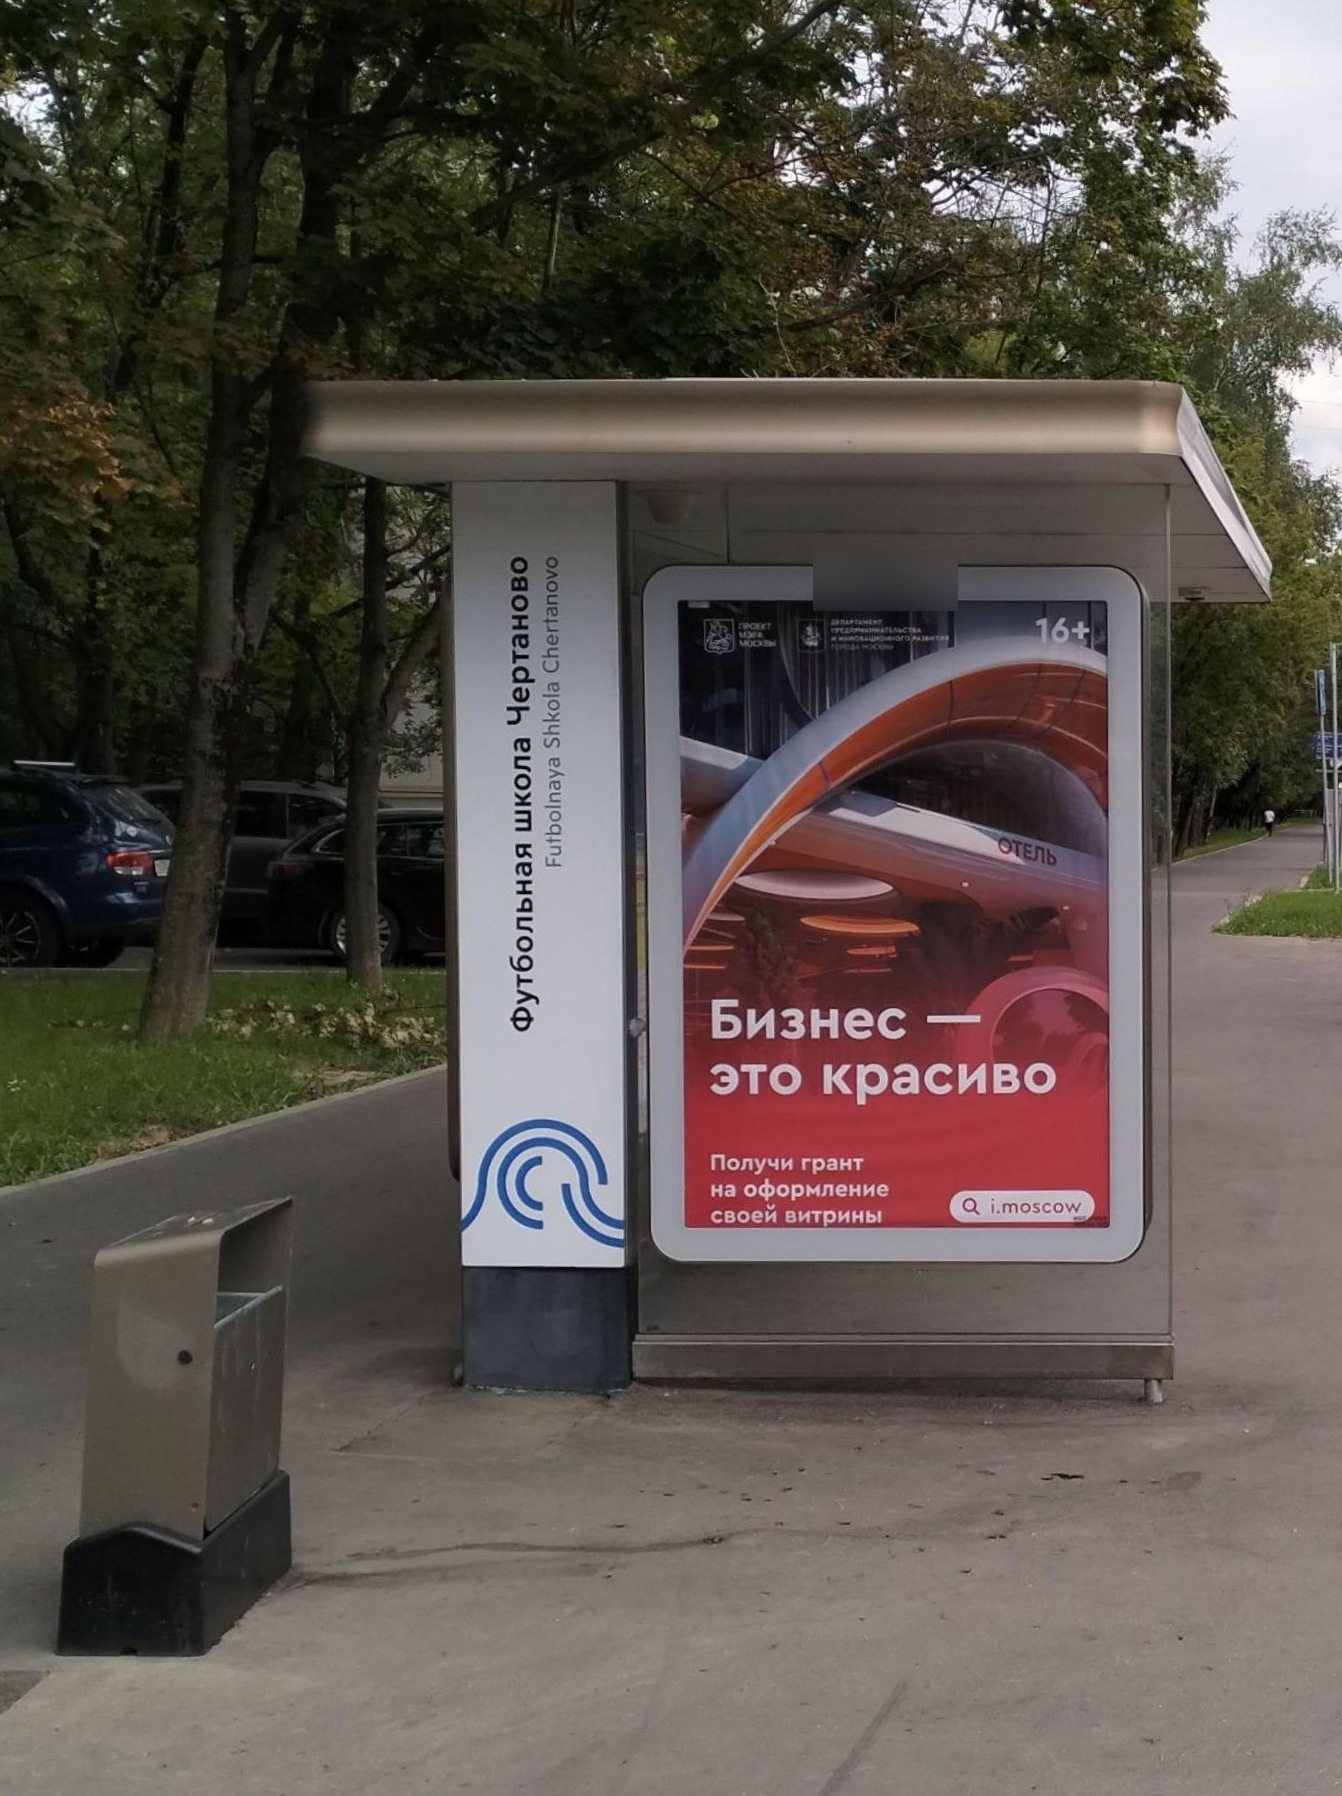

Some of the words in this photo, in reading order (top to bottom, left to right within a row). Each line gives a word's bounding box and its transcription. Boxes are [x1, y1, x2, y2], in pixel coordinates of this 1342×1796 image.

[541, 556, 560, 673] Chertanovo
[1035, 617, 1090, 644] 16+
[506, 556, 535, 726] Чертаново
[541, 681, 560, 749] Shkola
[513, 737, 532, 832] школа
[544, 756, 565, 867] Futbolnaya
[998, 837, 1057, 866] ОТЕЛЬ
[509, 843, 540, 1032] Футбольная
[711, 999, 907, 1040] Бизнес
[710, 1063, 802, 1095] это
[822, 1062, 1057, 1105] красиво
[710, 1154, 794, 1175] Получи
[801, 1157, 864, 1175] грант
[710, 1183, 736, 1198] на
[743, 1178, 890, 1201] оформление
[990, 1197, 1082, 1214] i.moscow
[710, 1204, 778, 1224] своей
[785, 1210, 882, 1226] витрины
